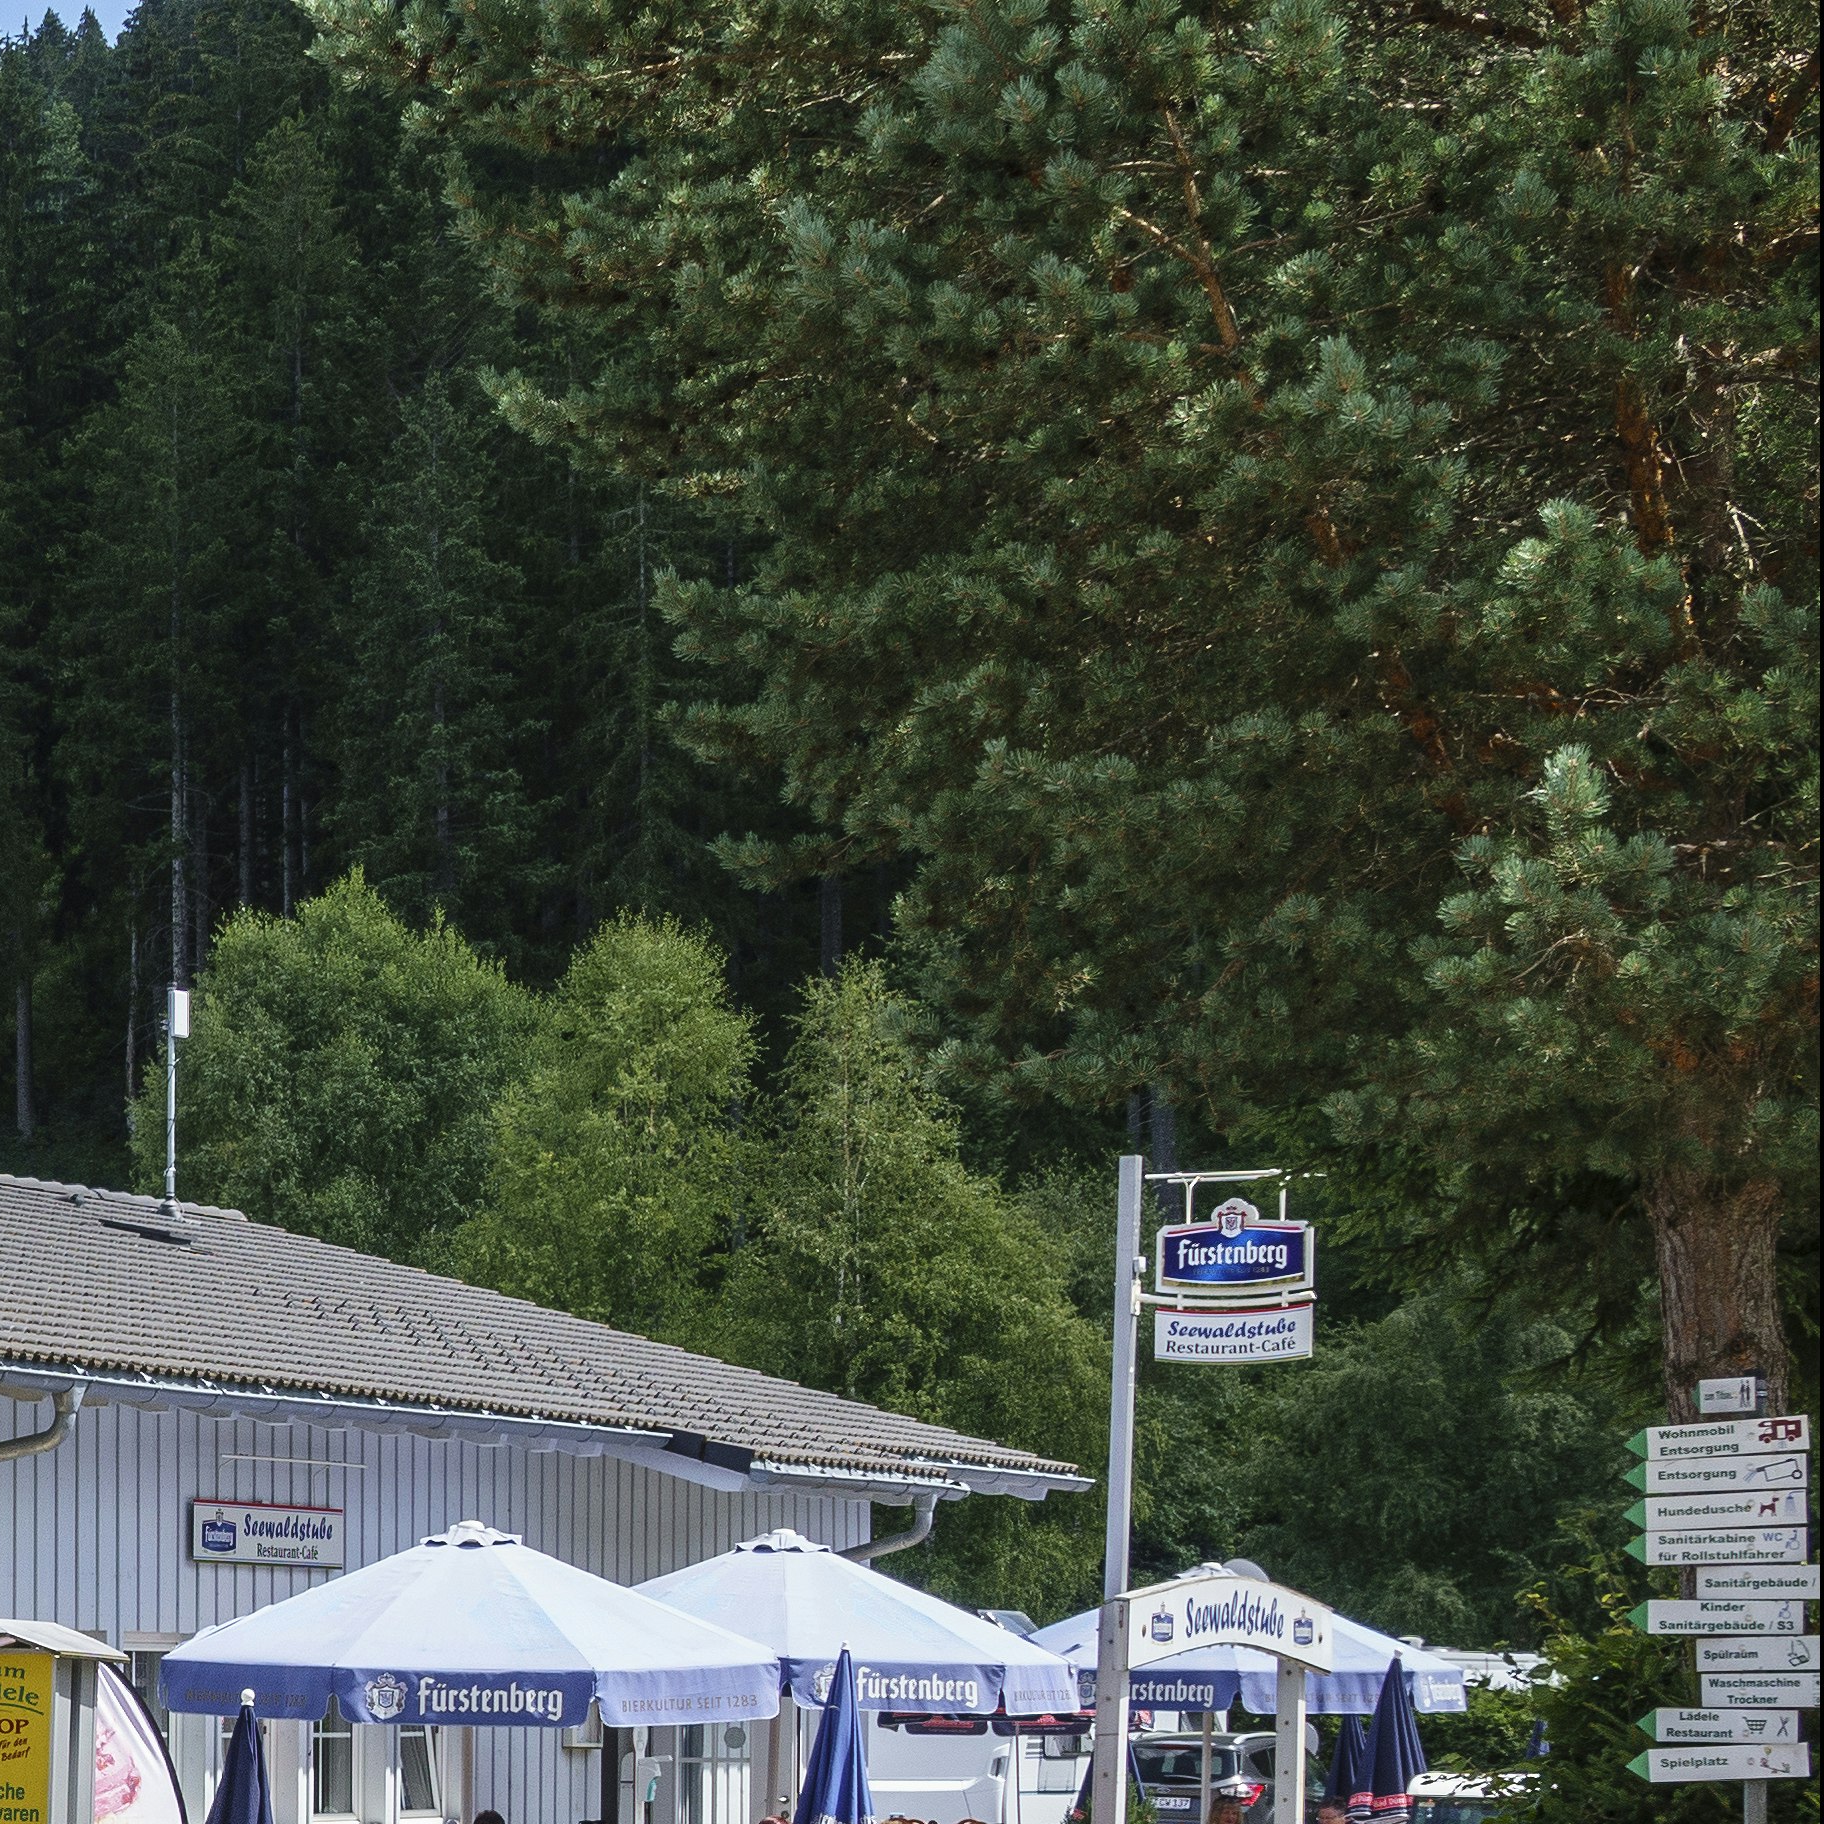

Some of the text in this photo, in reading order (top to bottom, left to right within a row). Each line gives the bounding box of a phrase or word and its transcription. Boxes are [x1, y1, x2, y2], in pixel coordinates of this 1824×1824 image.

[1177, 1238, 1288, 1270] Fürstenberg
[1167, 1318, 1297, 1340] Seewaldstube
[1165, 1336, 1297, 1355] Restaurant-Café
[1658, 1424, 1735, 1440] Wohnmobil
[1659, 1442, 1740, 1456] Entsorgung
[1658, 1469, 1737, 1481] Entsorgung
[1658, 1503, 1752, 1517] Hundedusche
[243, 1513, 333, 1542] Seewaldstube
[1658, 1532, 1783, 1546] Sanitärkabine WC
[256, 1542, 319, 1560] Restaurant-Café
[1658, 1549, 1785, 1562] für Rollstuhlfahrer
[1704, 1577, 1809, 1590] Sanitärgebäude
[1700, 1602, 1746, 1612] Kinder
[1185, 1590, 1284, 1639] Seewaldstube
[1659, 1620, 1766, 1632] Sanitärgebäude
[1777, 1620, 1795, 1631] S3
[1703, 1648, 1759, 1661] Spülraum
[855, 1666, 979, 1707] Fürstenberg
[1708, 1678, 1801, 1688] Waschmaschine
[417, 1676, 564, 1723] Fürstenberg
[1129, 1678, 1214, 1707] rstenberg
[1727, 1694, 1778, 1704] Trockner
[621, 1694, 758, 1713] BIERKULTUR SEIT 1283
[1679, 1711, 1720, 1721] Lädele
[1666, 1727, 1733, 1738] Restaurant
[13, 1737, 28, 1747] den
[1, 1746, 31, 1762] Bedarf
[1660, 1756, 1729, 1770] Spielplatz
